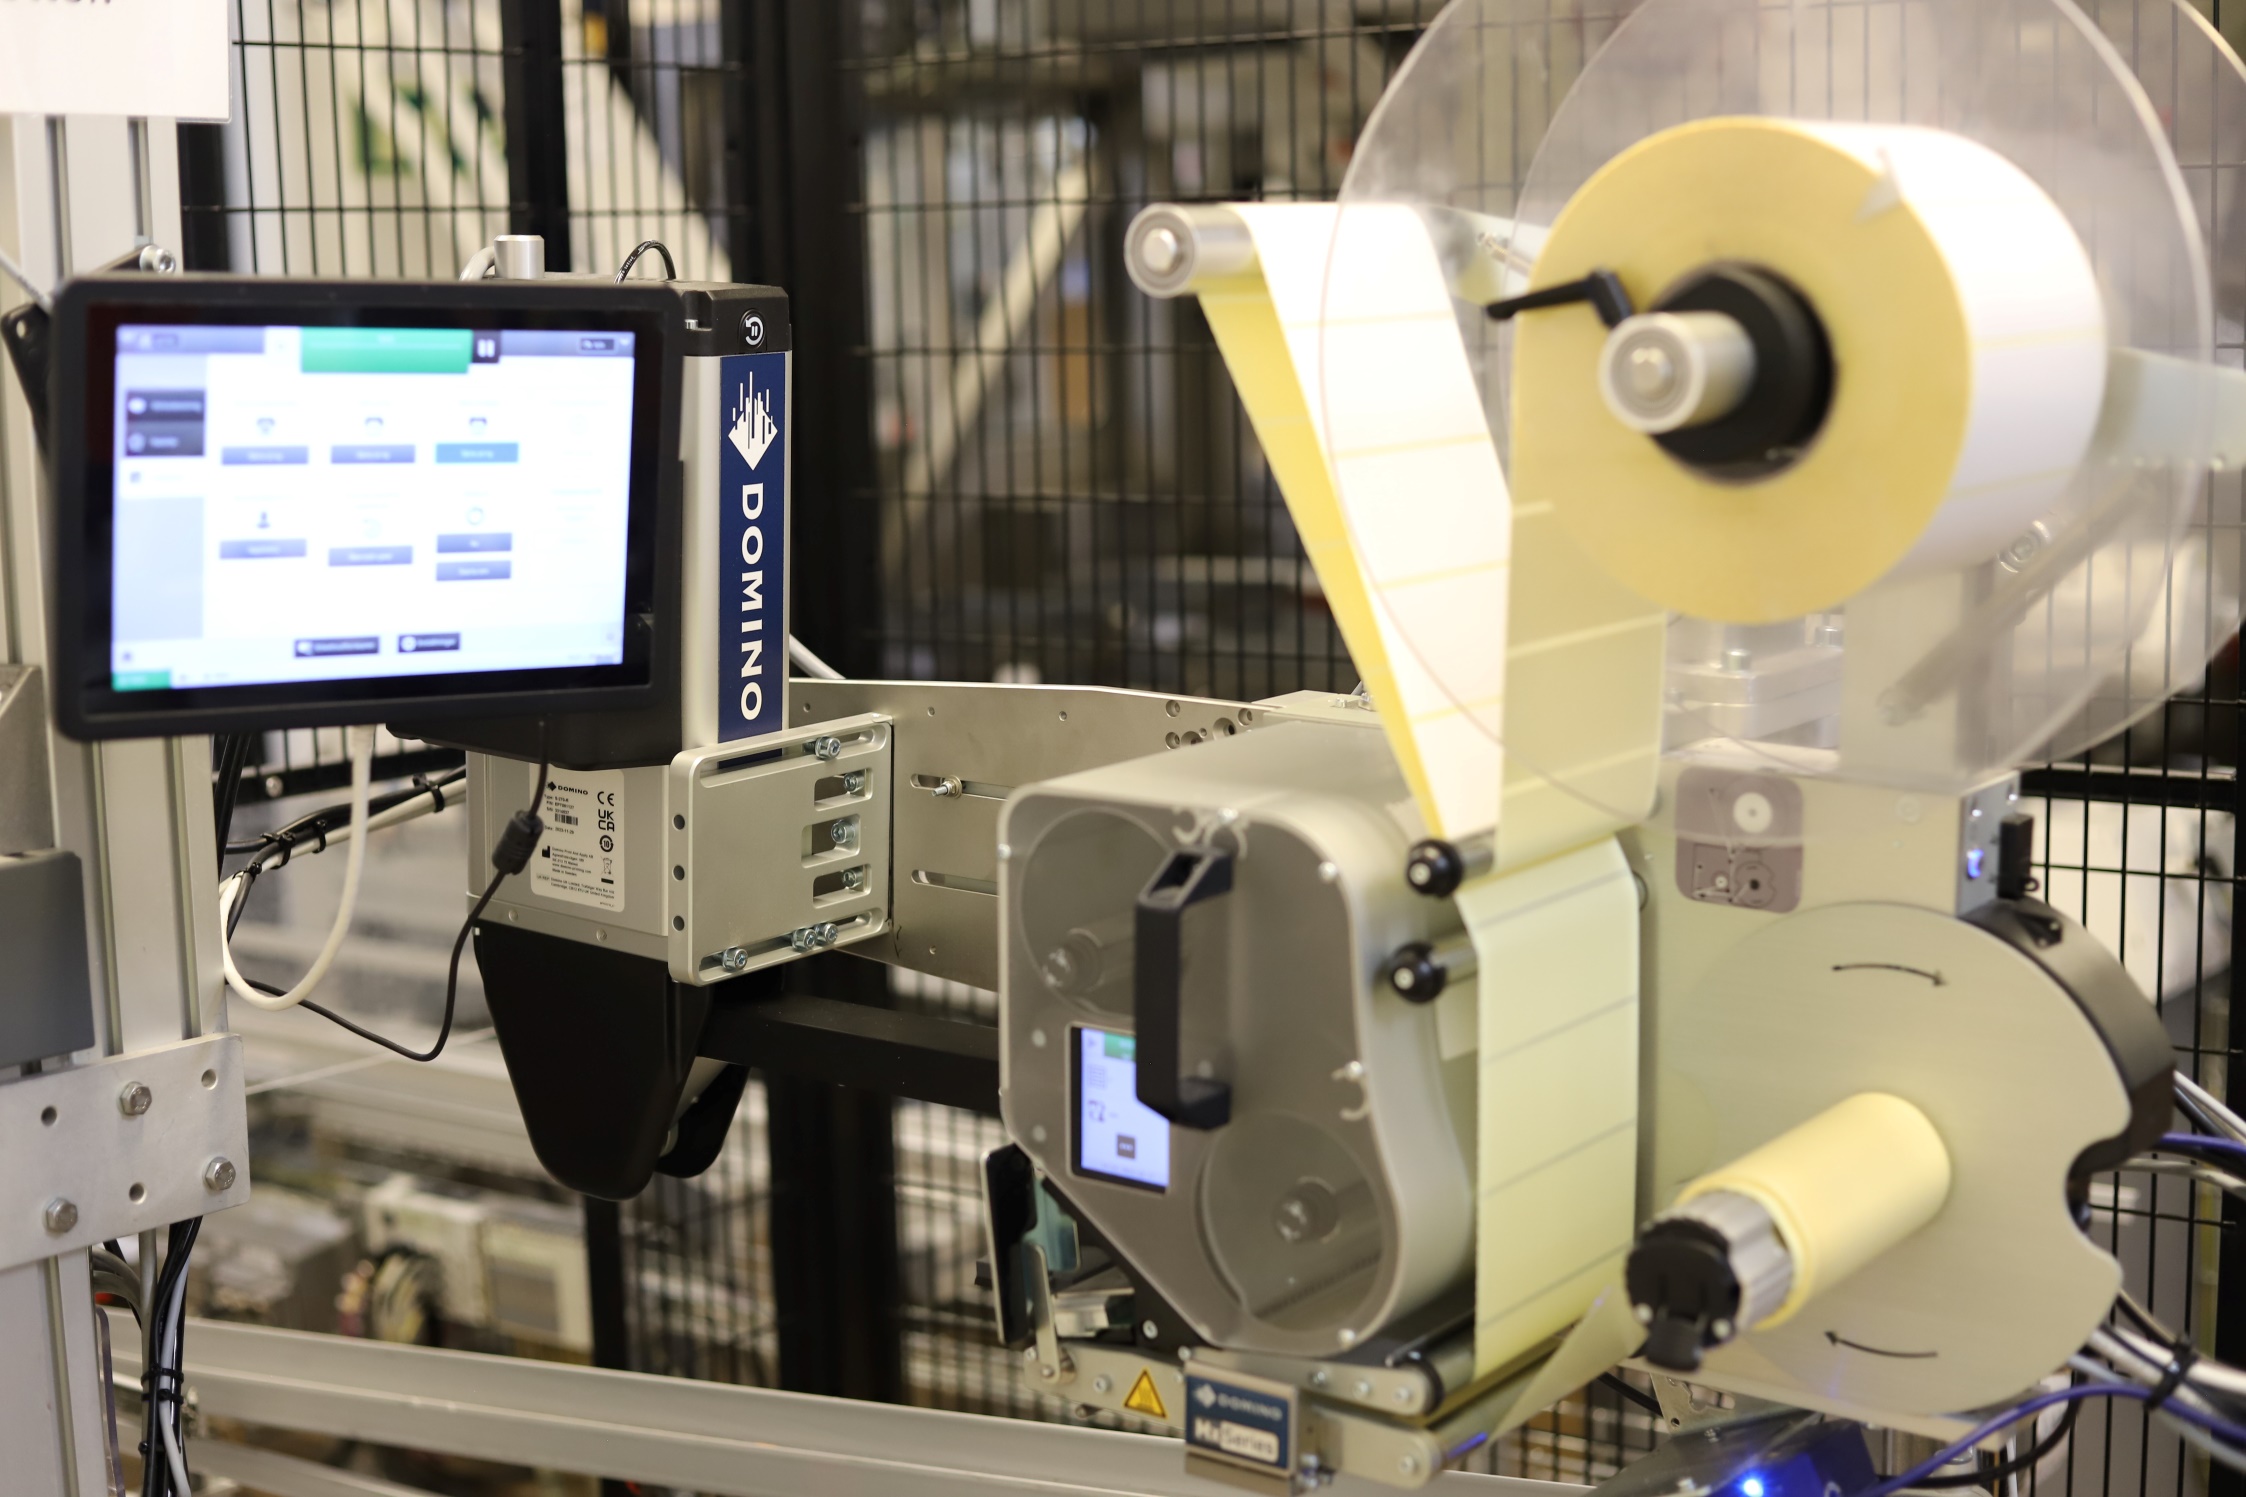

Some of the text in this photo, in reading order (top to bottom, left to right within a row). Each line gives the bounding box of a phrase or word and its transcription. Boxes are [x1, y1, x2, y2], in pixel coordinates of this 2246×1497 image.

[740, 482, 764, 721] DOMINO
[557, 785, 589, 795] DOMINO
[597, 791, 615, 807] CE
[598, 809, 614, 821] UK
[598, 819, 615, 832] CA
[603, 840, 610, 848] 10
[1217, 1393, 1283, 1421] DOMINO
